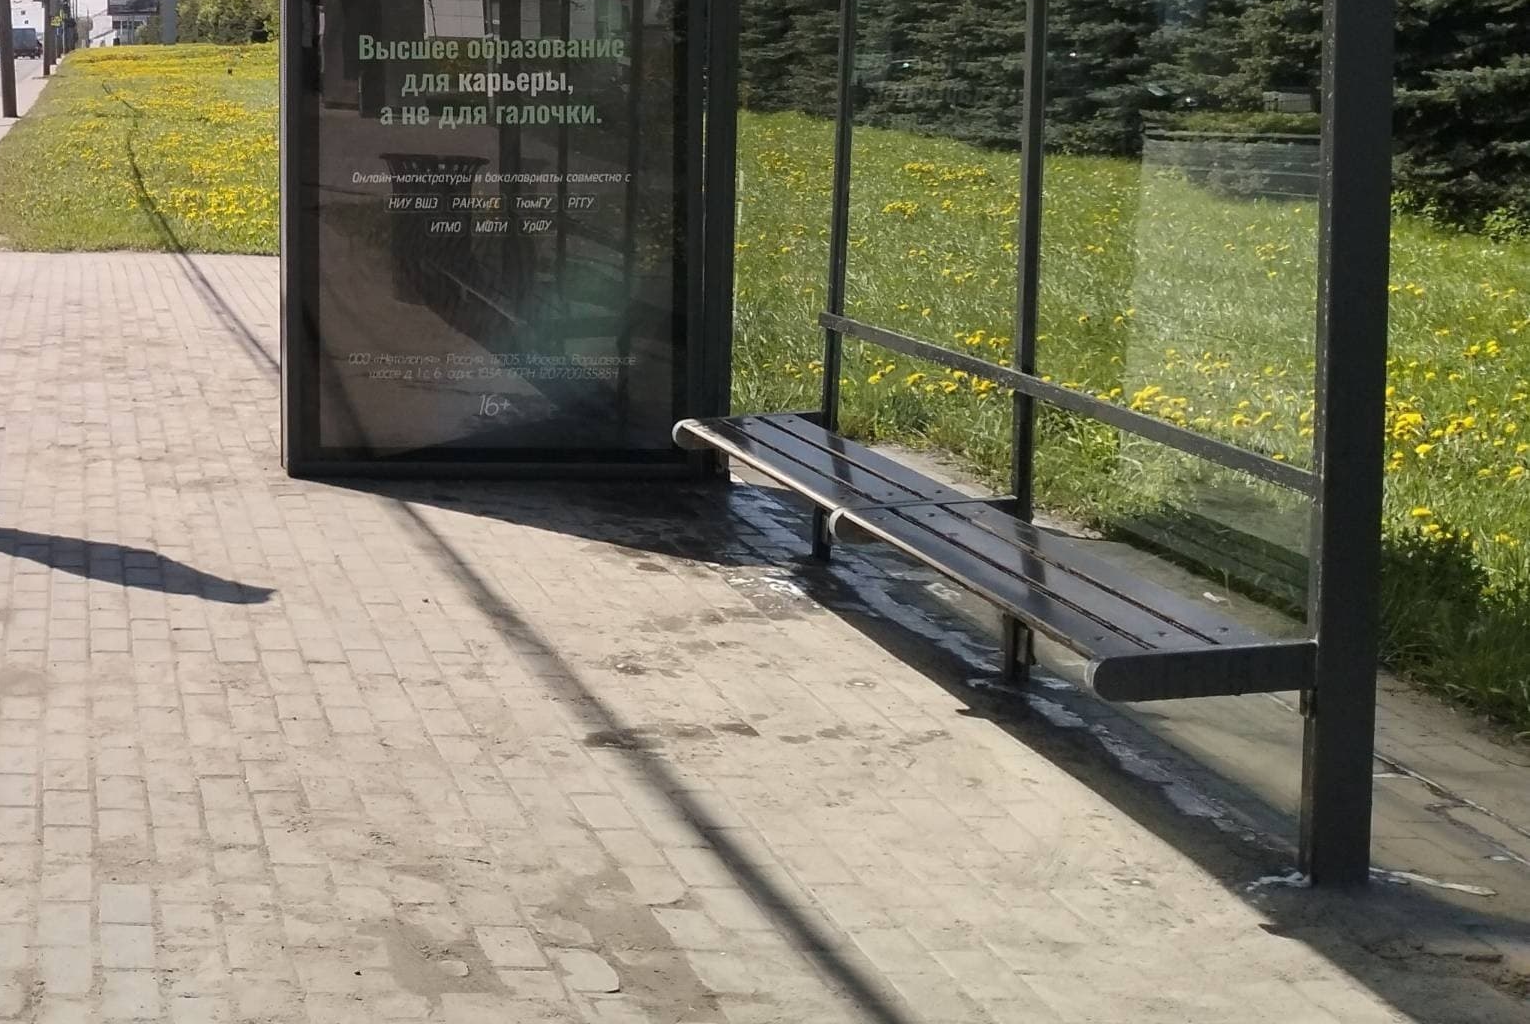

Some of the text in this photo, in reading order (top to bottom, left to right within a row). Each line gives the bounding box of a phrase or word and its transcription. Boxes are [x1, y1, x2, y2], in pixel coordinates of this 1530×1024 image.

[358, 34, 625, 65] Высшее образование
[401, 71, 574, 97] для карьеры,
[379, 104, 603, 130] а не для галочки.
[351, 172, 631, 185] Онлайн-магистратуры и бакалавриаты совместно с
[388, 197, 412, 209] НИУ
[451, 197, 501, 209] РАНХиГС
[515, 197, 553, 209] ТюмГУ
[567, 197, 595, 209] РГГУ
[430, 219, 553, 234] ИТМО МФТИ УрФУ
[478, 394, 512, 416] 16+
